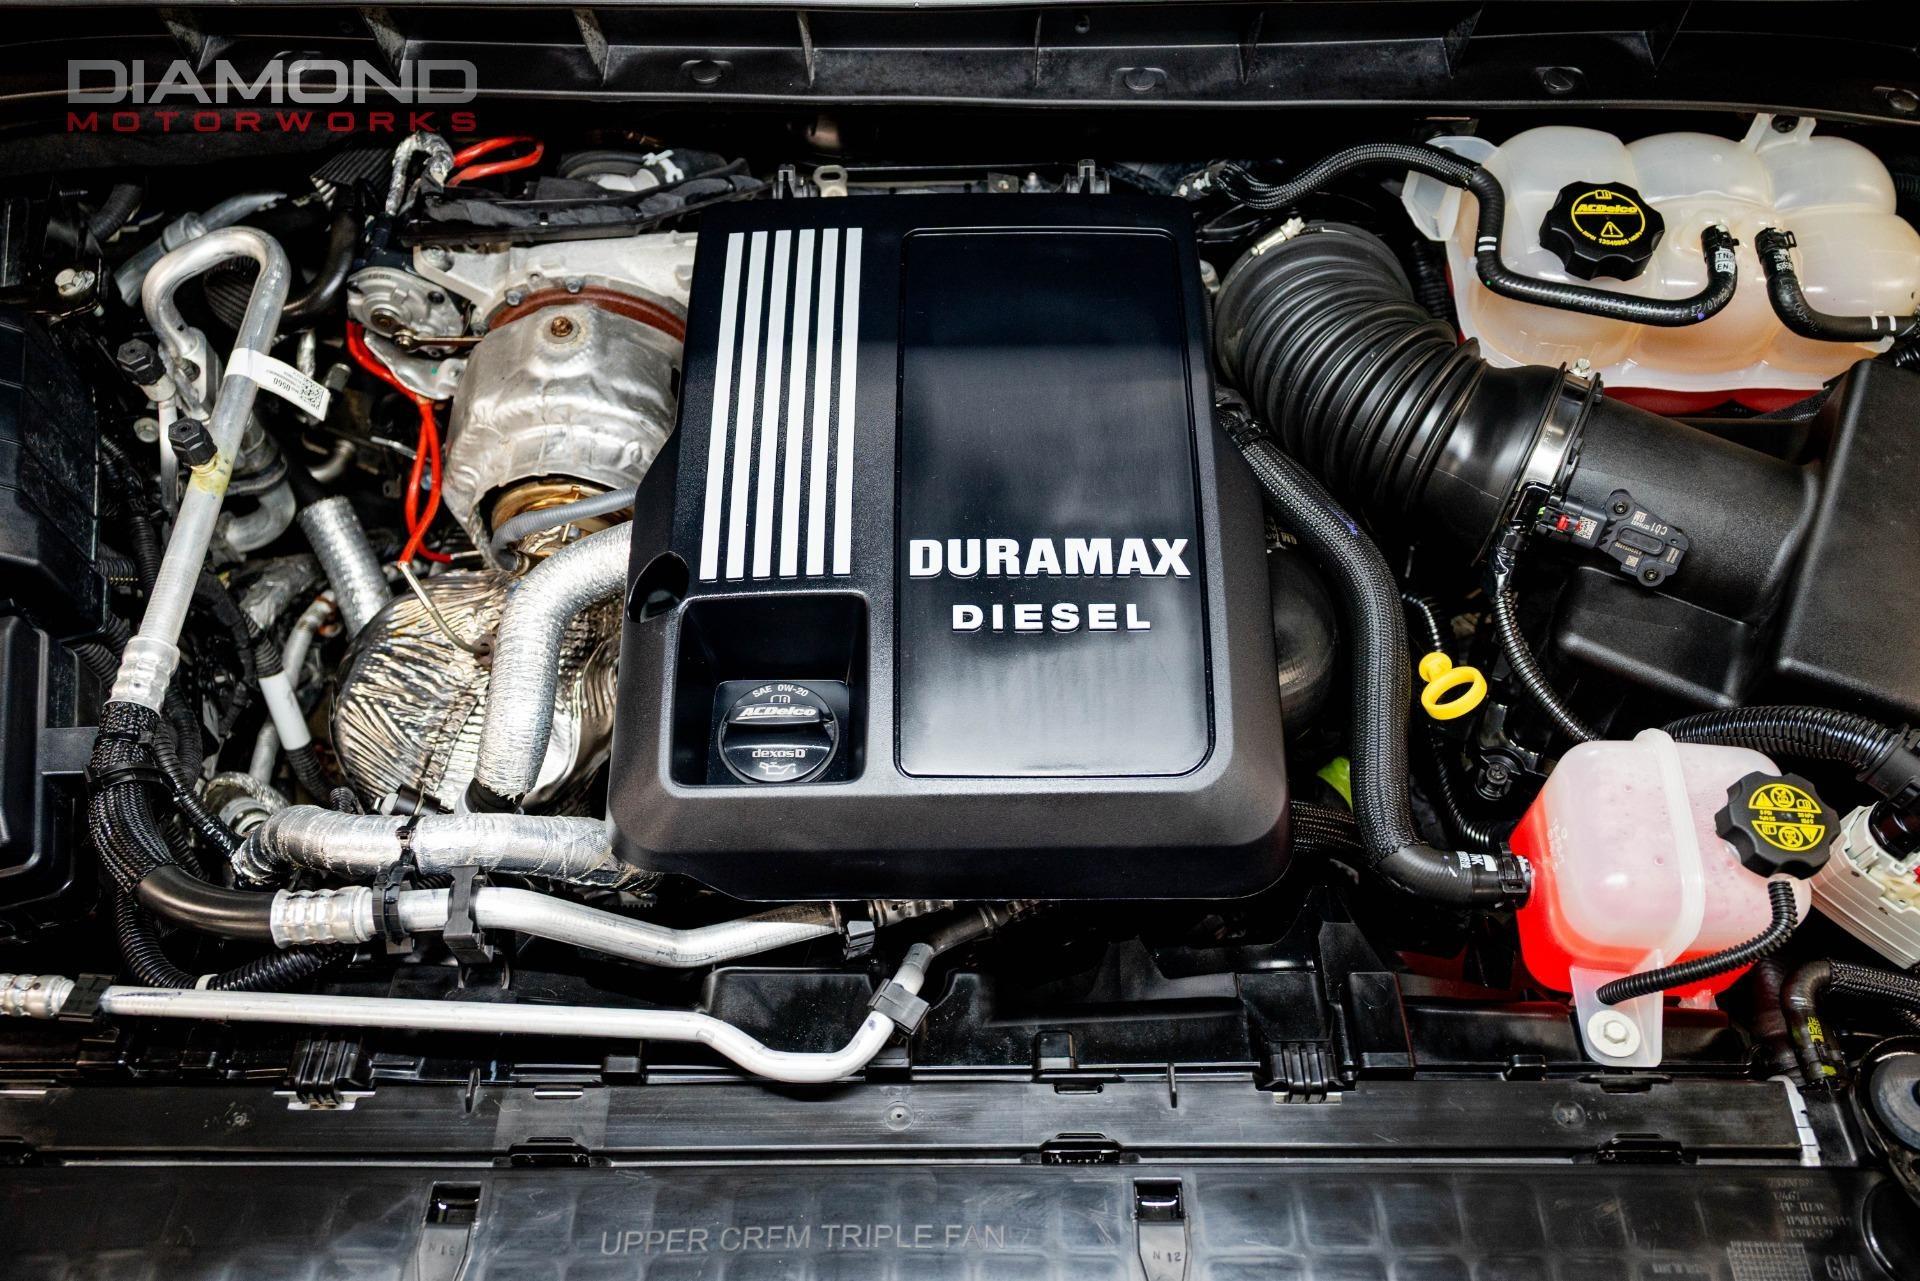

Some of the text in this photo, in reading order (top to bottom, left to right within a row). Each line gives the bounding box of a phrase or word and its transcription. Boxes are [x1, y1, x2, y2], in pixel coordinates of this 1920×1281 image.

[1575, 203, 1639, 214] ACDelco
[908, 537, 1192, 577] DURAMAX
[952, 602, 1151, 631] DIESEL
[752, 683, 809, 698] SAE 0W-20
[736, 706, 817, 720] ACDelco
[600, 1224, 1006, 1256] UPPER CRFM TRIPLE FAN
[1166, 1250, 1182, 1263] 12
